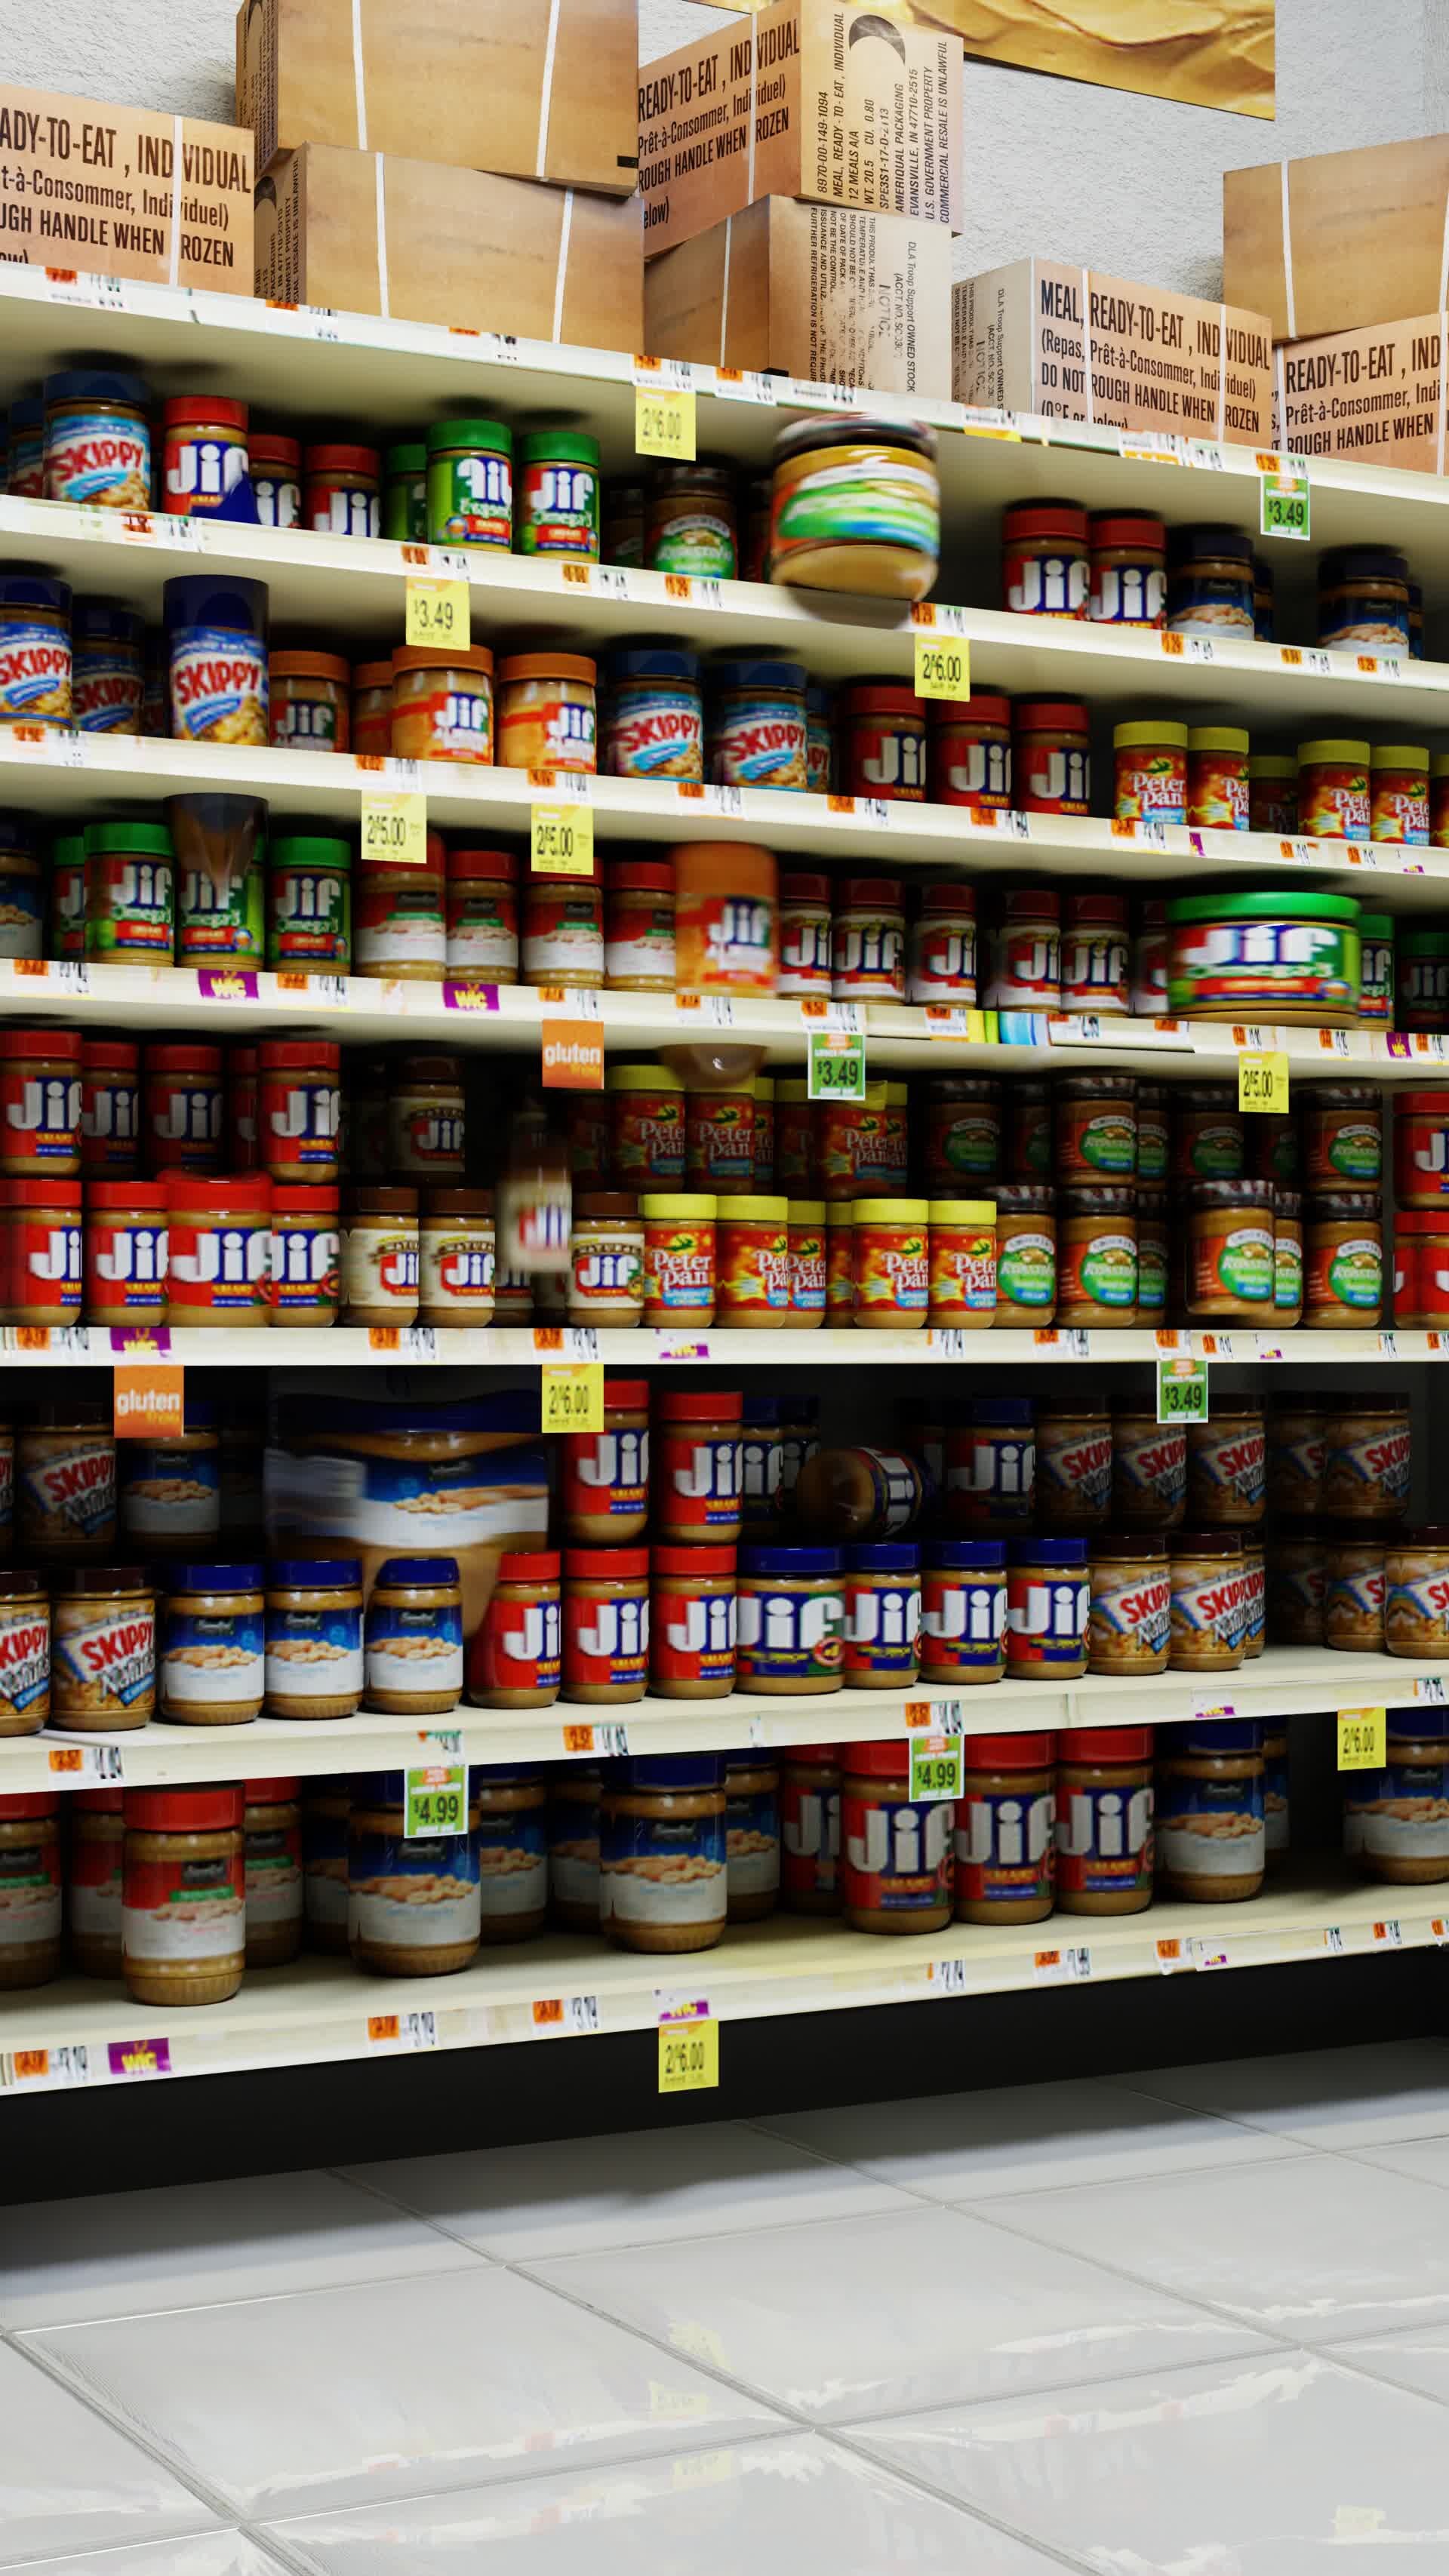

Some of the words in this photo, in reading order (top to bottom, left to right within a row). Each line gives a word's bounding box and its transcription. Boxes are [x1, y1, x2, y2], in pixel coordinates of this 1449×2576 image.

[834, 11, 844, 72] INDIVIDUAL
[638, 54, 718, 122] READY-TO-EAT
[730, 19, 800, 82] INDVIDUAL
[937, 41, 947, 95] UNLAWFUL
[733, 73, 786, 116] Indiiduel)
[909, 69, 918, 131] 47710-2515
[923, 66, 934, 118] PROPERTY
[938, 98, 948, 109] IS
[833, 106, 844, 118] TO
[865, 99, 875, 122] 0.80
[894, 83, 904, 144] PACKAGING
[817, 91, 829, 193] 8970-00-149-1094
[833, 127, 844, 161] READY
[850, 131, 860, 148] A/A
[909, 134, 918, 145] IN
[938, 112, 949, 149] RESALE
[0, 107, 117, 168] ADY-TO-EAT
[138, 134, 251, 194] INDVIDUAL
[639, 157, 671, 192] ROUGH
[675, 139, 714, 177] HANDLE
[716, 124, 746, 159] WHEN
[755, 106, 789, 143] ROZEN
[924, 121, 935, 197] GOVERNMENT
[849, 151, 859, 186] MEALS
[864, 160, 874, 180] 20.5
[894, 147, 905, 213] AMERIQUAL
[1, 165, 136, 216] t-à-Consommer,
[143, 189, 229, 231] Indiiduel)
[850, 188, 859, 201] 12
[938, 150, 949, 224] COMMERCIAL
[644, 196, 669, 230] elow)
[924, 198, 935, 220] U.S.
[40, 209, 109, 247] HANDLE
[114, 221, 165, 256] WHEN
[181, 233, 234, 267] ROZEN
[907, 241, 916, 260] DLA
[848, 265, 856, 275] BE
[906, 263, 916, 287] Troop
[810, 319, 817, 327] IS
[906, 288, 915, 324] Support
[906, 324, 915, 359] OWNED
[1041, 279, 1084, 330] MEAL,
[1091, 291, 1184, 349] READY-TO-EAT
[1197, 320, 1270, 371] INDVIDUAL
[995, 334, 1004, 367] Support
[1041, 328, 1085, 363] (Repas,
[1201, 366, 1256, 403] Indiiduel)
[906, 361, 915, 392] STOCK
[996, 368, 1004, 401] OWNED
[1286, 343, 1395, 394] READY-TO-EAT
[1041, 362, 1057, 388] DO
[1063, 367, 1085, 394] NOT
[1092, 373, 1130, 405] ROUGH
[1135, 383, 1179, 415] HANDLE
[1182, 394, 1215, 423] WHEN
[1225, 404, 1260, 433] ROZEN
[1287, 430, 1331, 456] ROUGH
[1337, 420, 1389, 450] HANDLE
[1393, 412, 1434, 440] WHEN
[52, 438, 144, 482] SKIPPY
[531, 466, 592, 512] Jif
[1268, 499, 1304, 527] $3.49
[174, 661, 260, 705] SKIPPY
[275, 704, 335, 736] Jif
[435, 693, 490, 728] Jif
[617, 713, 701, 752] SKIPPY
[723, 724, 806, 761] SKIPPY
[1131, 773, 1185, 793] Peter
[1140, 791, 1183, 810] Pan
[1331, 788, 1371, 810] Pete
[110, 865, 172, 906] Jif
[275, 878, 341, 918] Jif
[1182, 926, 1339, 966] Jif
[454, 988, 488, 1010] WIC
[543, 1041, 601, 1068] gluten
[817, 1059, 859, 1087] $3.49
[697, 1120, 753, 1143] Peter
[707, 1140, 750, 1160] Pan
[171, 1231, 272, 1283] Jif
[578, 1255, 639, 1285] Jif
[652, 1250, 712, 1272] Peter
[661, 1268, 709, 1288] Pan
[116, 1388, 180, 1416] gluten
[1165, 1386, 1202, 1412] $3.49
[1120, 1581, 1171, 1624] SKIPP
[737, 1596, 844, 1649] Jif
[81, 1619, 153, 1670] SKIPPY
[918, 1760, 957, 1789] $4.99
[414, 1794, 460, 1825] $4.99
[1057, 1791, 1154, 1856] Jif
[848, 1803, 956, 1874] Jif
[954, 1800, 1056, 1865] Jif
[122, 2051, 157, 2073] WIC
